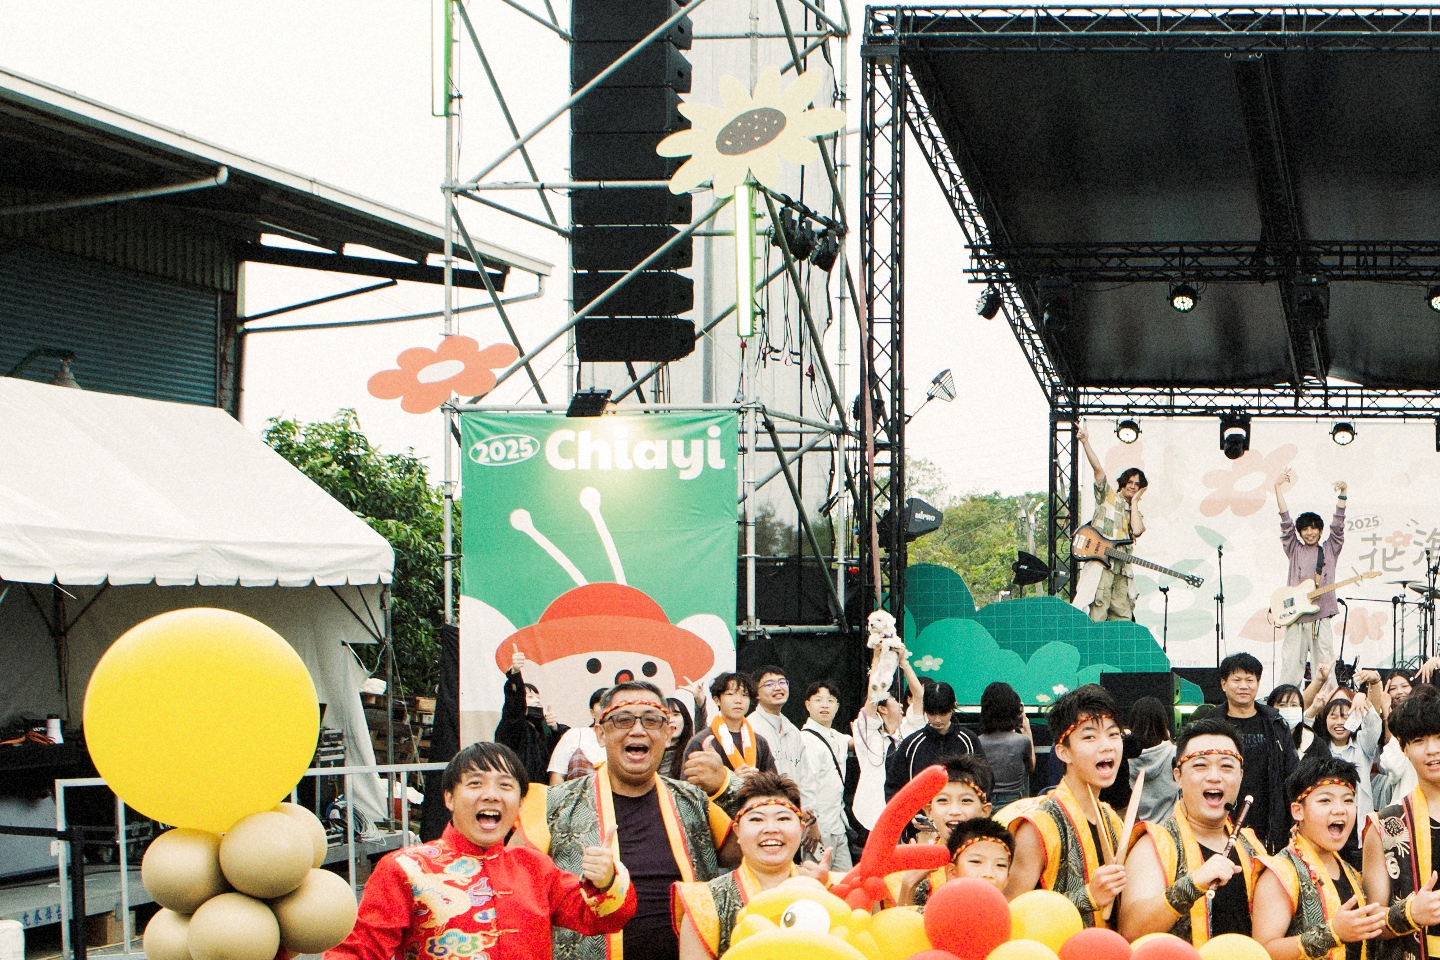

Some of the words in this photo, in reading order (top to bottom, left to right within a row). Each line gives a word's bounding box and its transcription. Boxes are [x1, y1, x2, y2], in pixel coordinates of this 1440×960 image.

[476, 437, 534, 463] 2025
[545, 425, 726, 480] Chiayi
[1346, 516, 1381, 532] 2025
